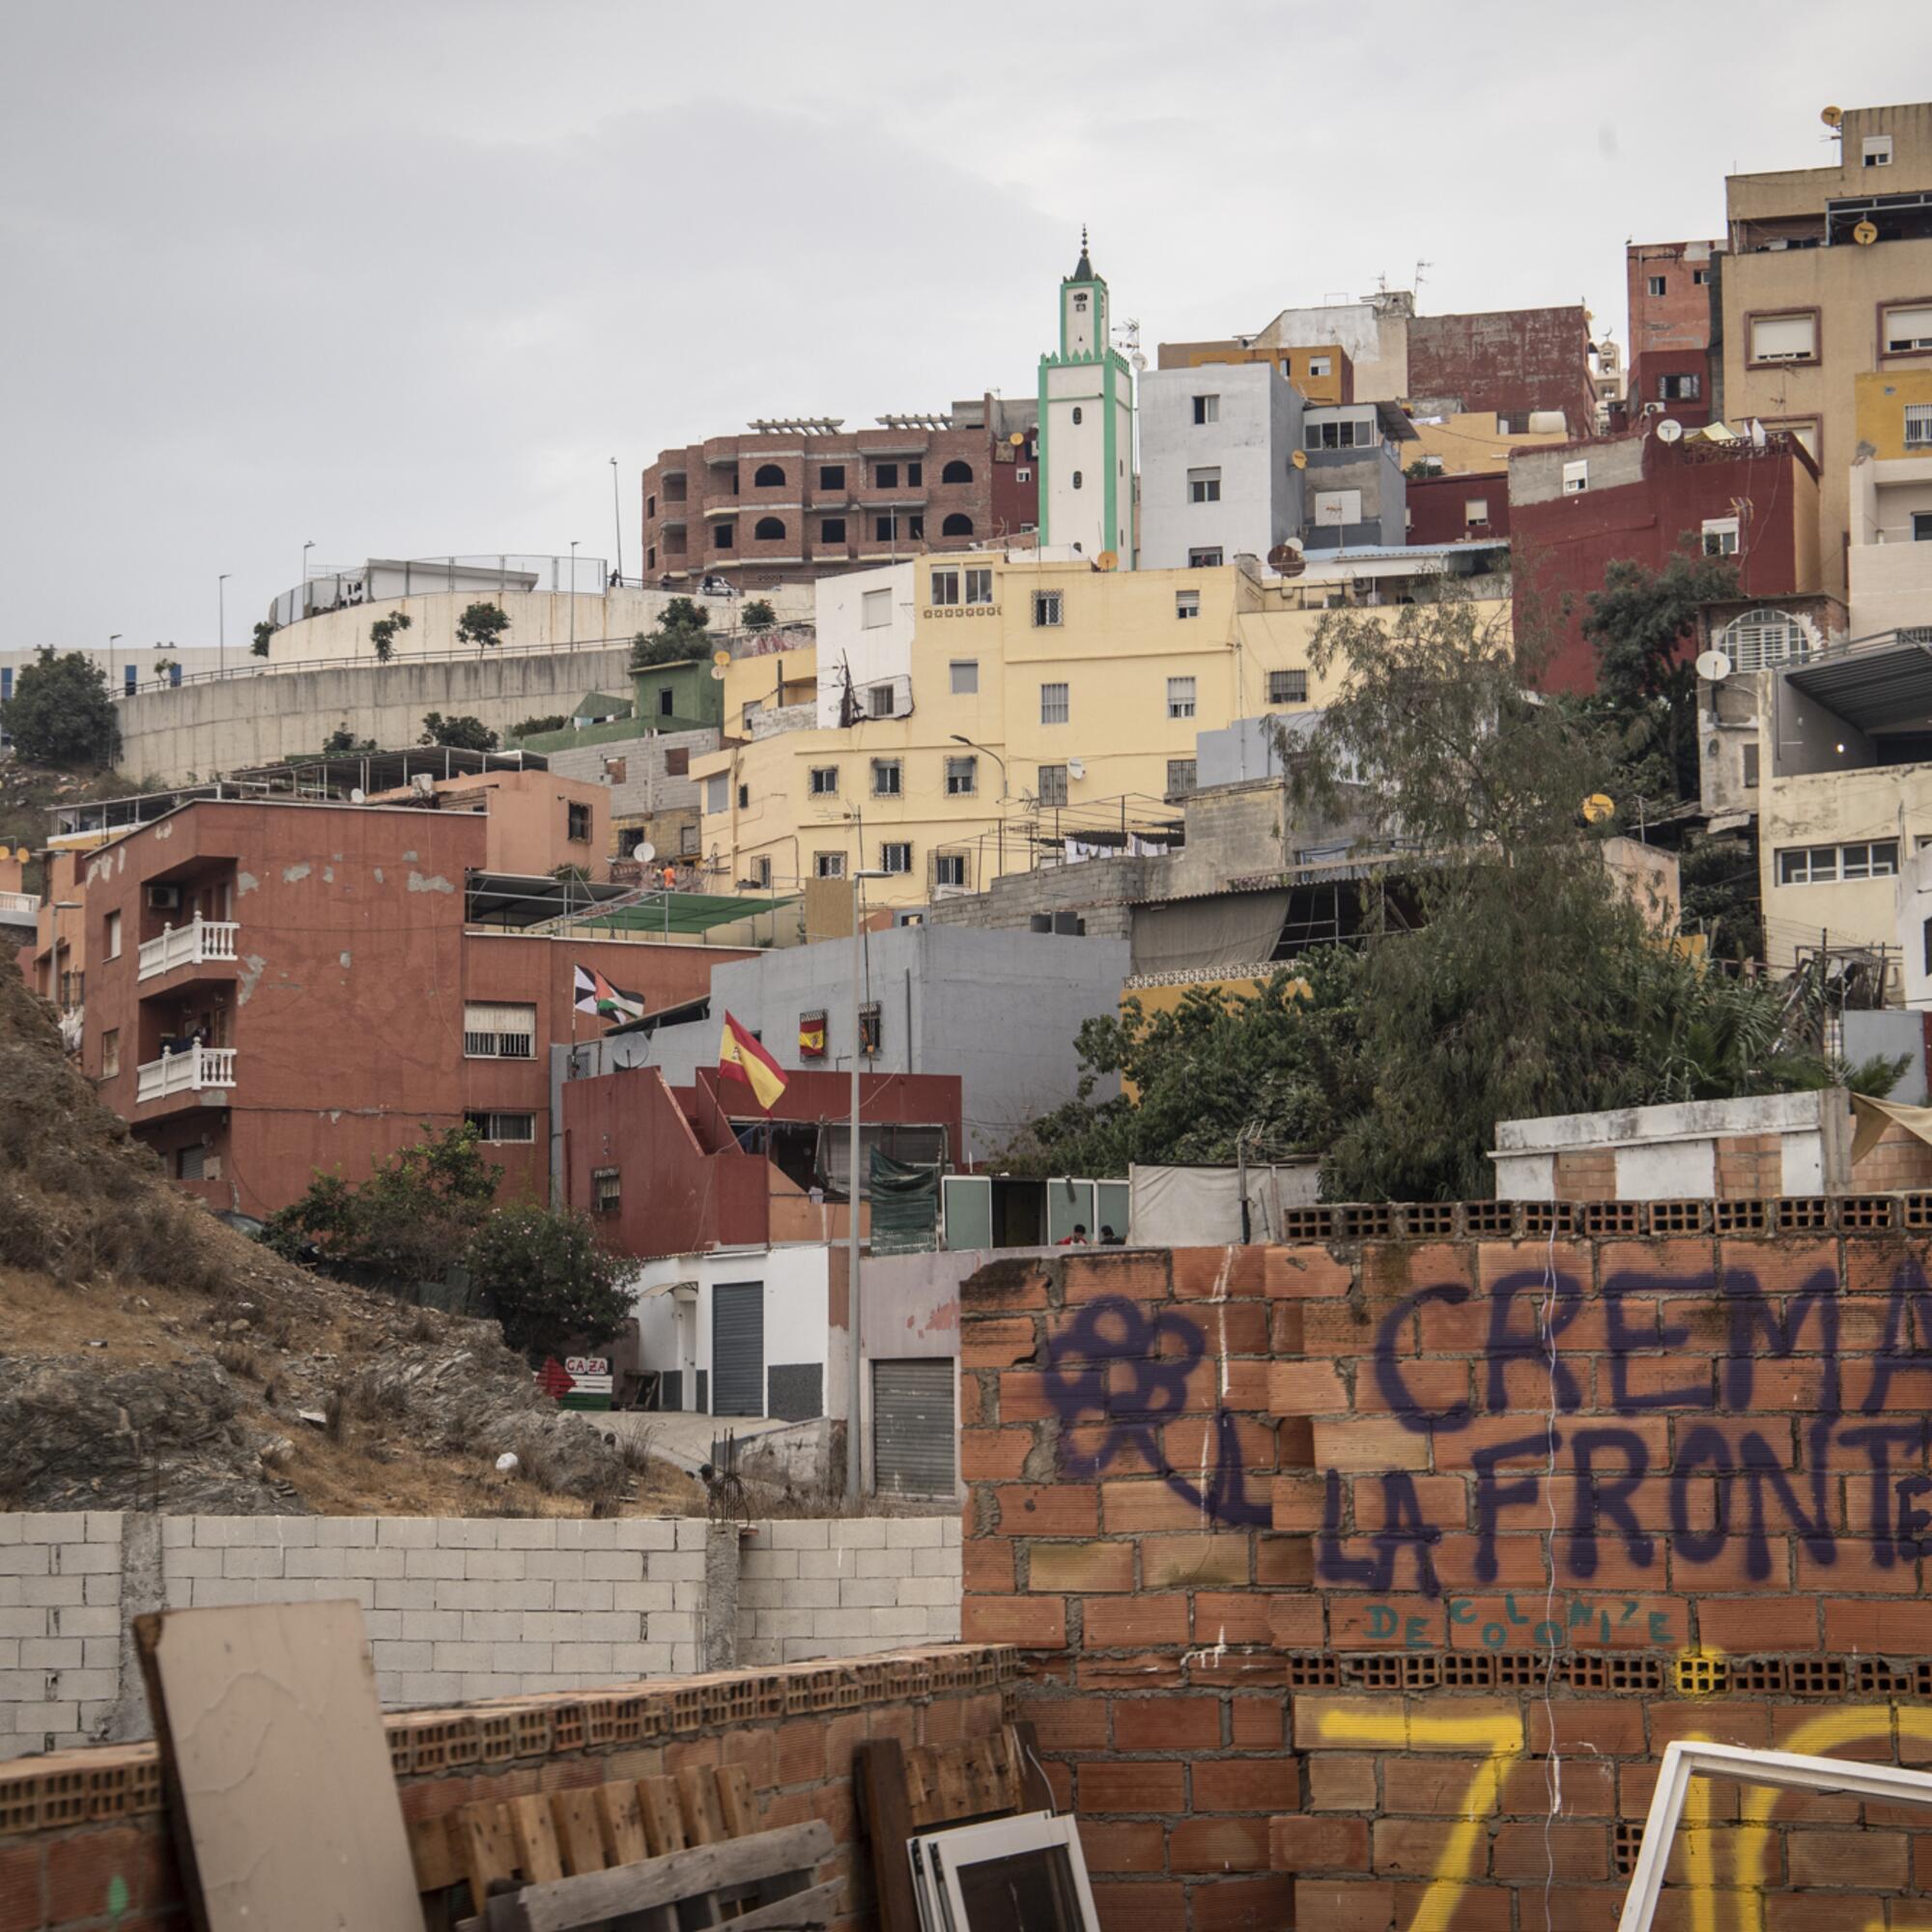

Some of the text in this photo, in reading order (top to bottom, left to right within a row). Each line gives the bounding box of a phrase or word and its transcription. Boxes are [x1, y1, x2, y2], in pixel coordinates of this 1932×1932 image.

[567, 1358, 607, 1373] GAZA
[1319, 1468, 1442, 1599] LA
[1361, 1593, 1675, 1649] DECOLONIZE
